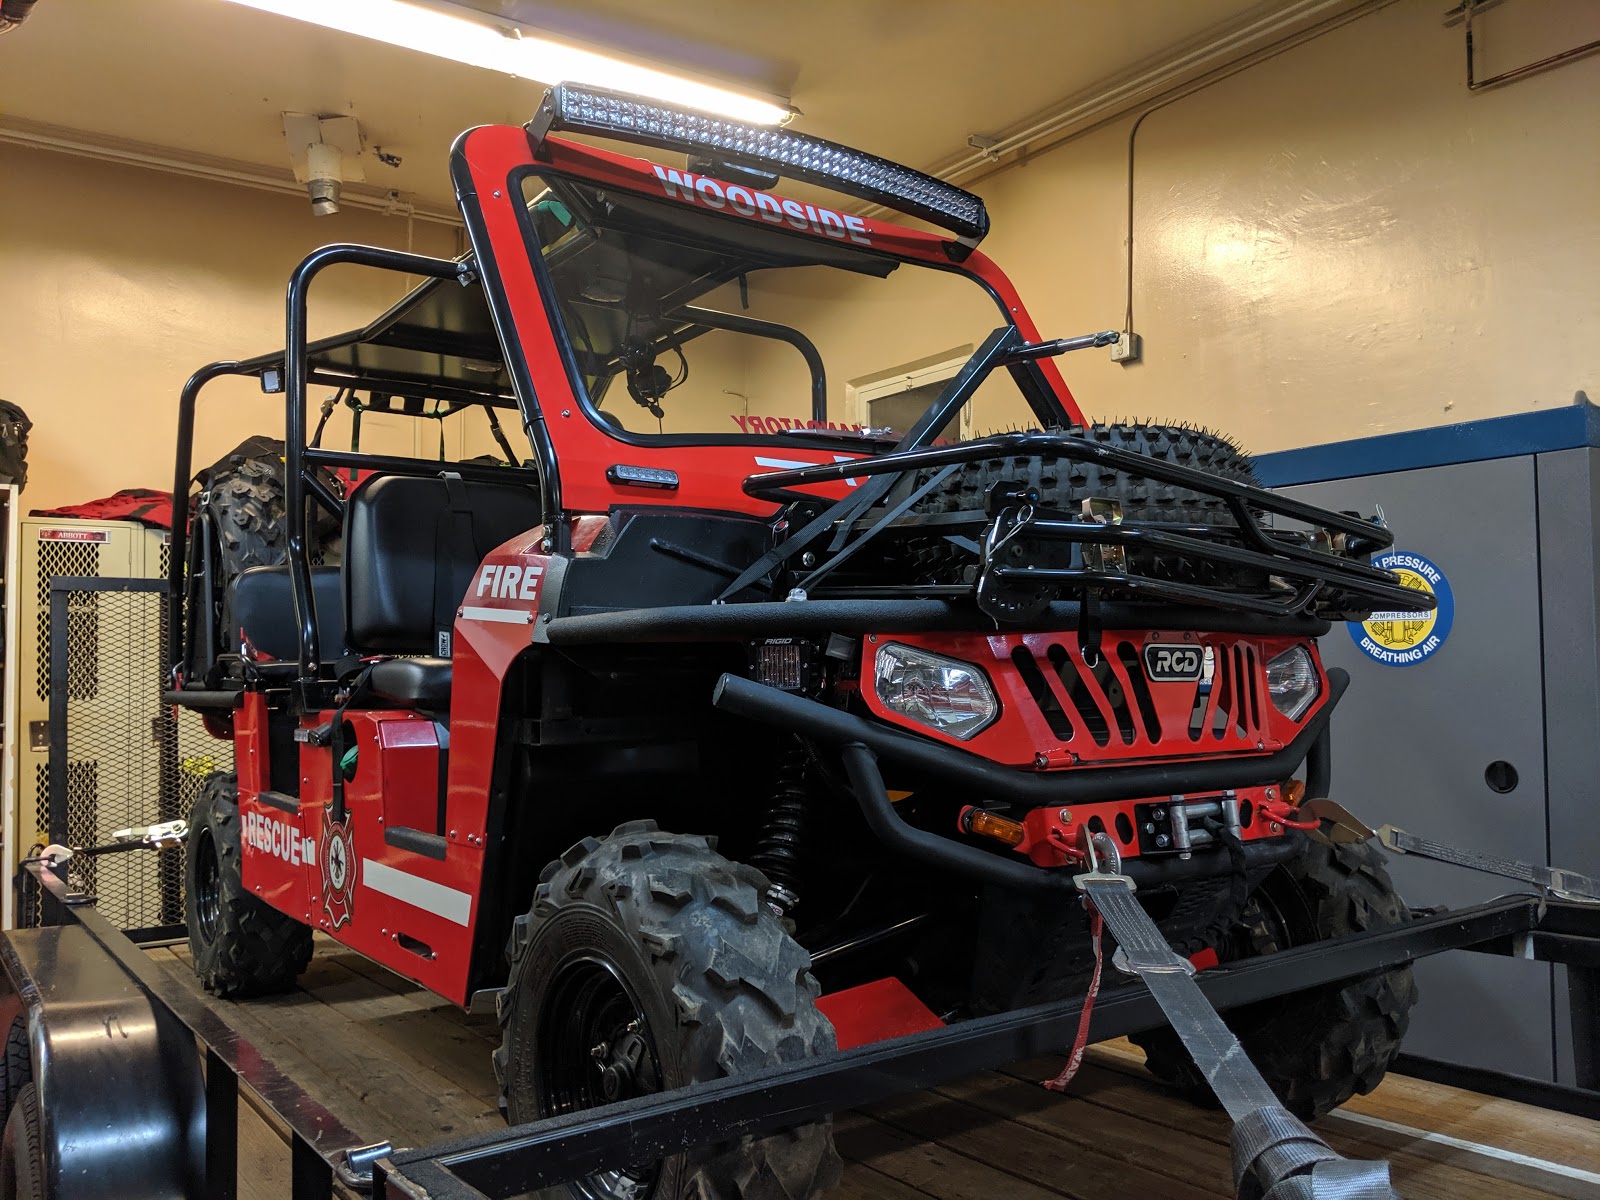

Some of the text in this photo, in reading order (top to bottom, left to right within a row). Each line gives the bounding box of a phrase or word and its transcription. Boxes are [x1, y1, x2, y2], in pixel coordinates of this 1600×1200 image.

[653, 165, 872, 245] WOODSIDE
[58, 532, 88, 540] ABBOTT
[477, 565, 544, 600] FIRE
[1381, 555, 1441, 585] PRESSURE
[1369, 611, 1429, 620] COMPRESSORS
[1156, 651, 1198, 672] RCD
[1360, 635, 1441, 663] BREATHING AIR
[247, 811, 300, 867] RESCUE
